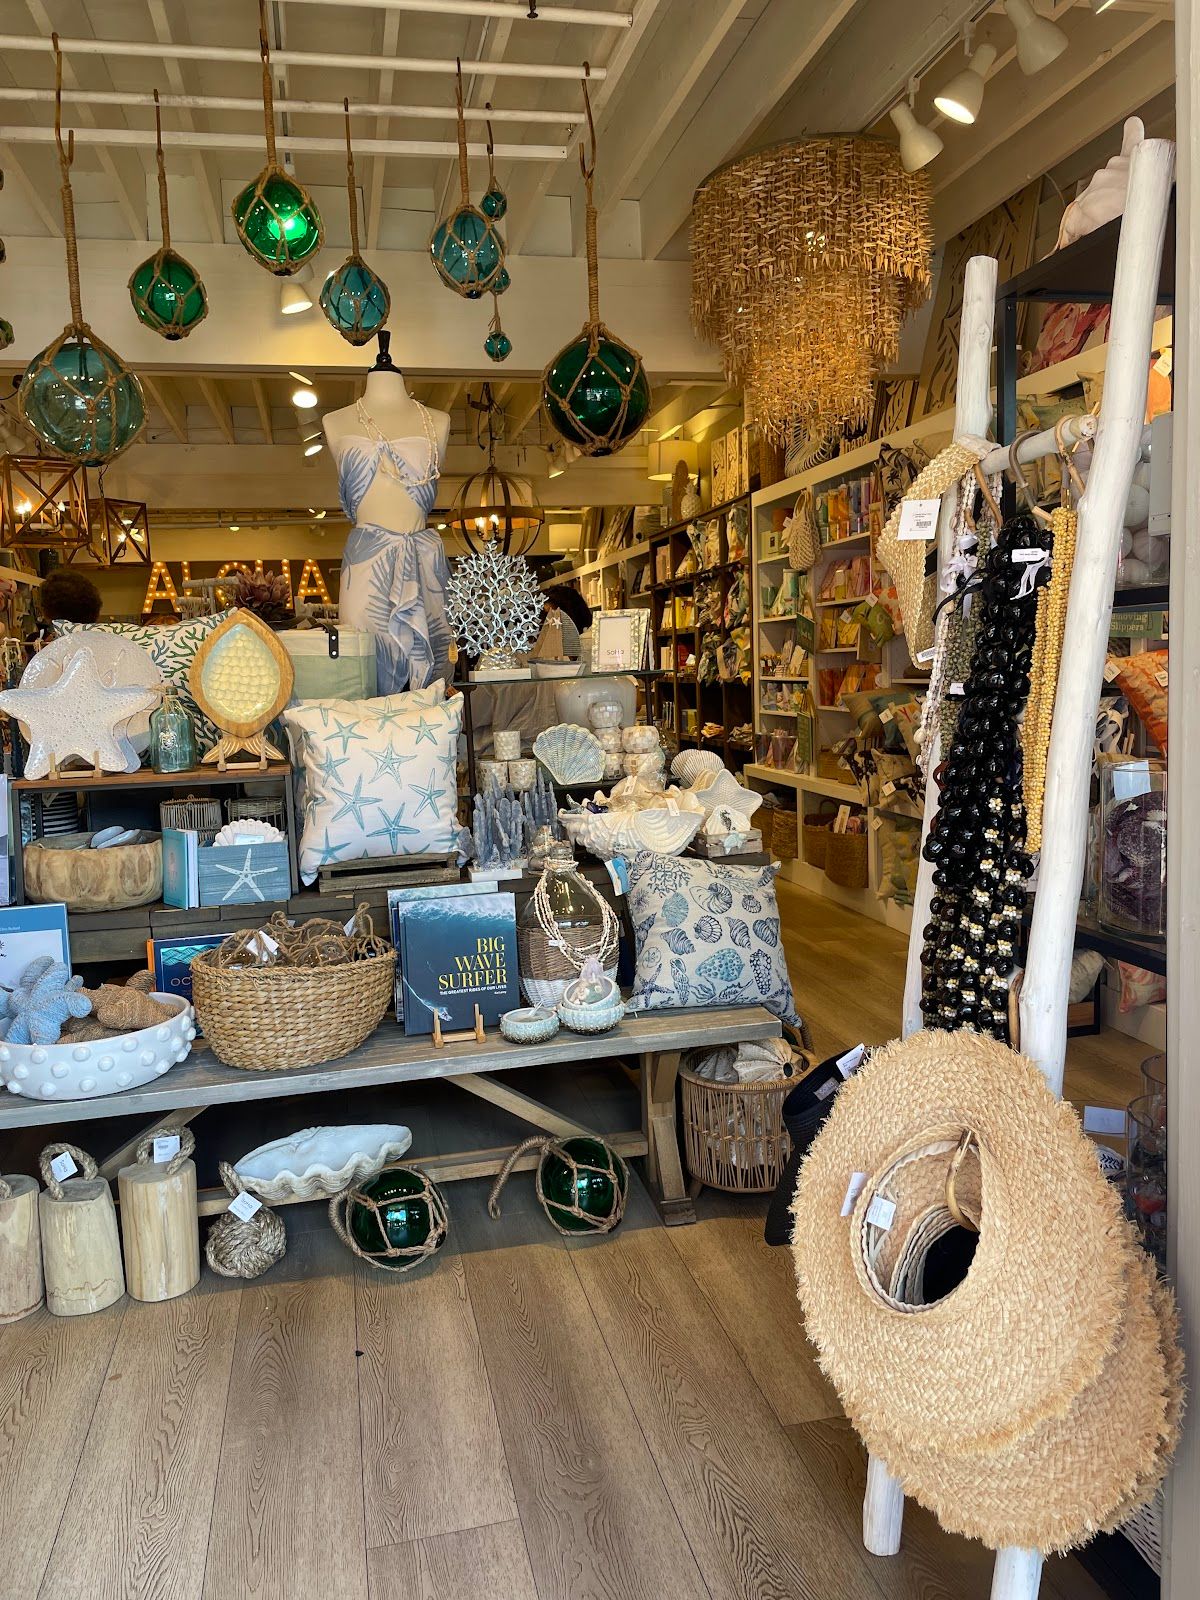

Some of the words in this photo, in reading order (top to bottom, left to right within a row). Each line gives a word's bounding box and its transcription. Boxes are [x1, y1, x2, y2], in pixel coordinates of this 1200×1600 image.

[1111, 612, 1148, 622] emoving
[1111, 621, 1144, 632] Slippers
[477, 936, 505, 954] BIG
[454, 952, 506, 972] WAVE
[438, 968, 507, 990] SURFER
